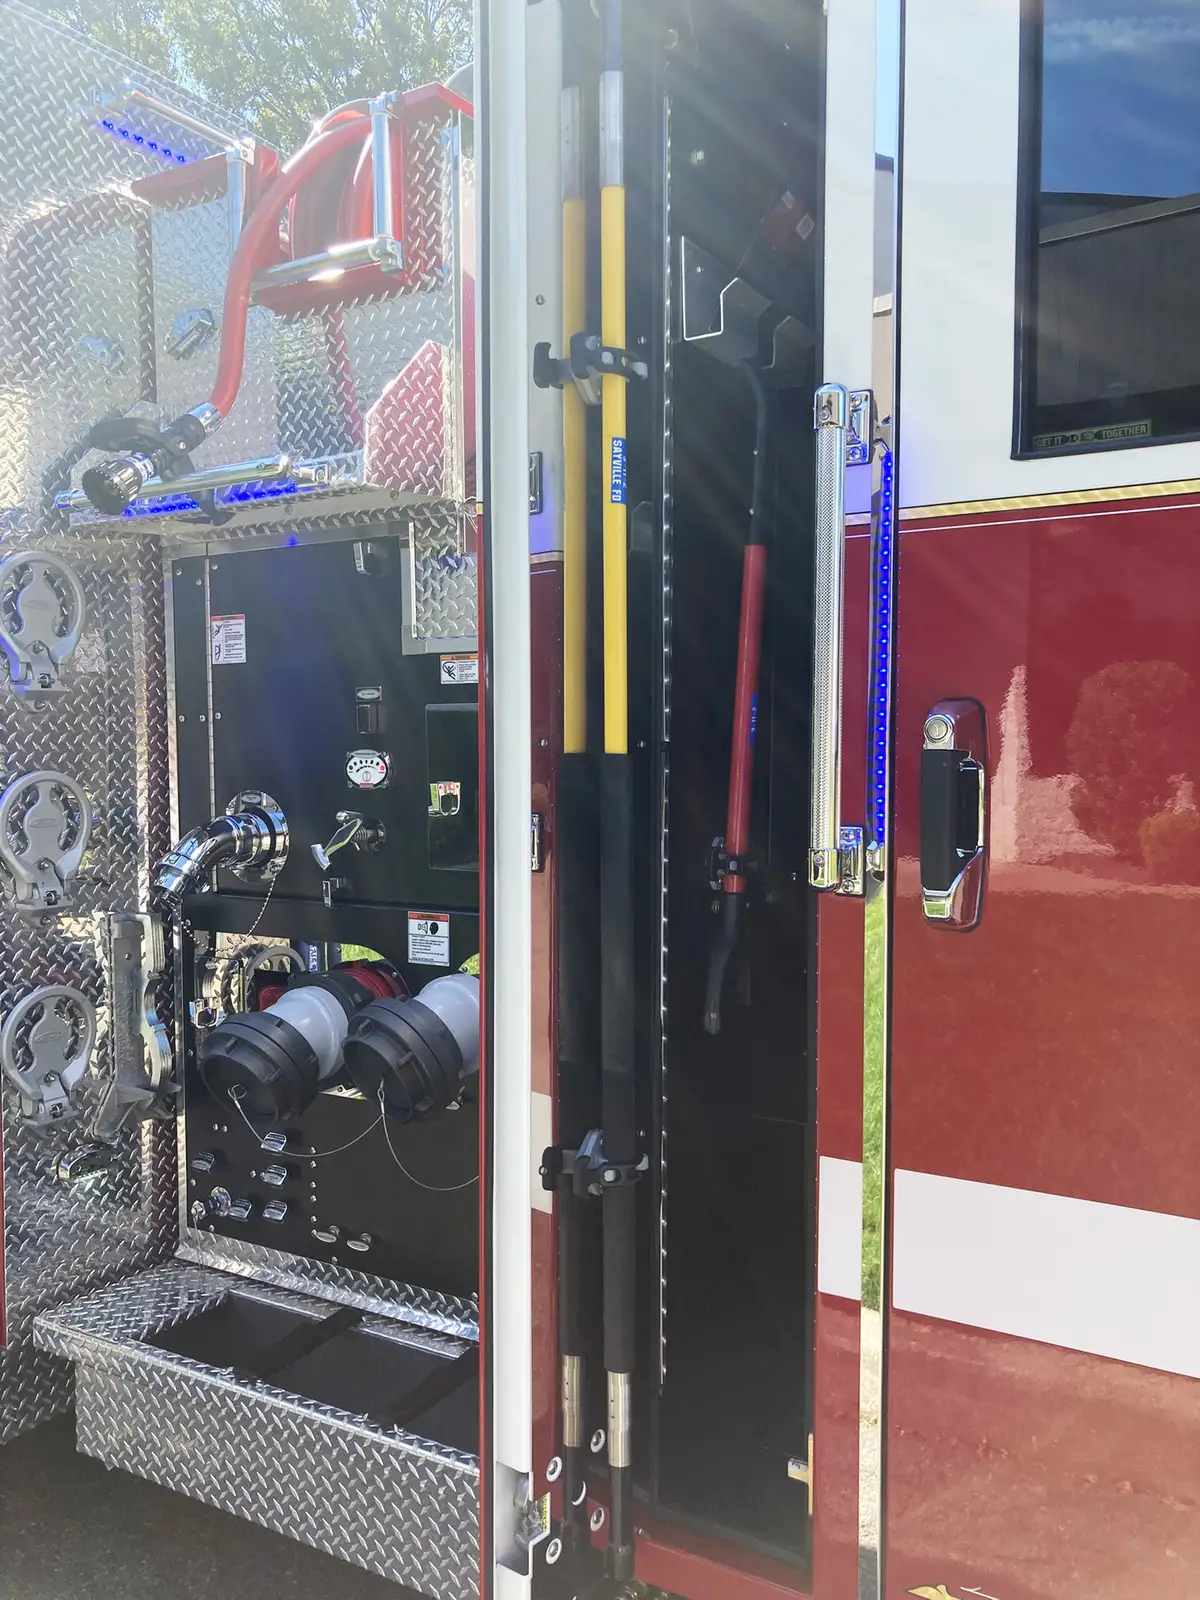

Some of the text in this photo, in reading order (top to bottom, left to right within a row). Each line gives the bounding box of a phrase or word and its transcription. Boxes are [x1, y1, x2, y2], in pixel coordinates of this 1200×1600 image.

[1036, 425, 1146, 447] GET IT TOGETHER
[613, 439, 622, 485] SAYVILLE
